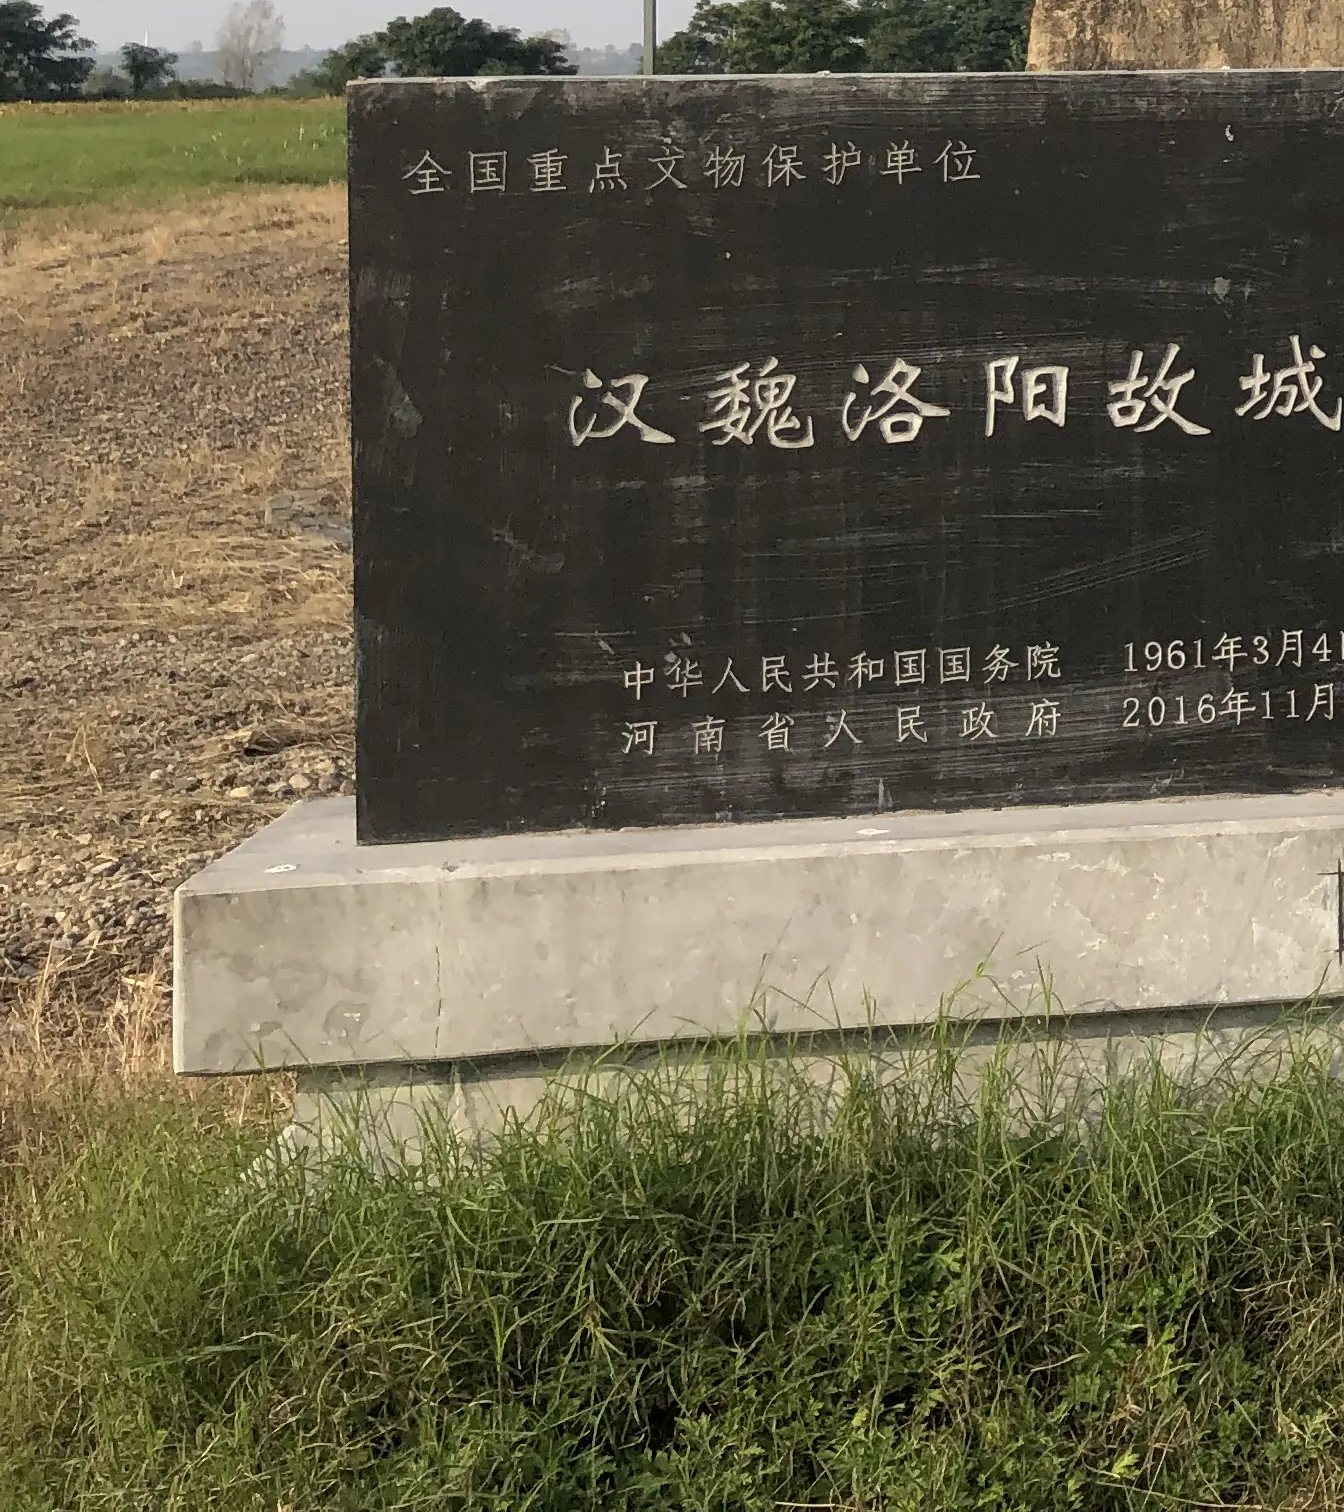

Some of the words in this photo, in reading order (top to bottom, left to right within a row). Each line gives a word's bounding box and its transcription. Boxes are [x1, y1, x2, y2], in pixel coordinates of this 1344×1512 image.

[401, 139, 982, 196] 全国重点文物保护单位
[568, 334, 1344, 449] 汉魏洛阳故城
[621, 642, 1063, 702] 中华人民共和国国务院
[621, 697, 1062, 755] 河南省人民政府
[1122, 685, 1335, 728] 2016年11月
